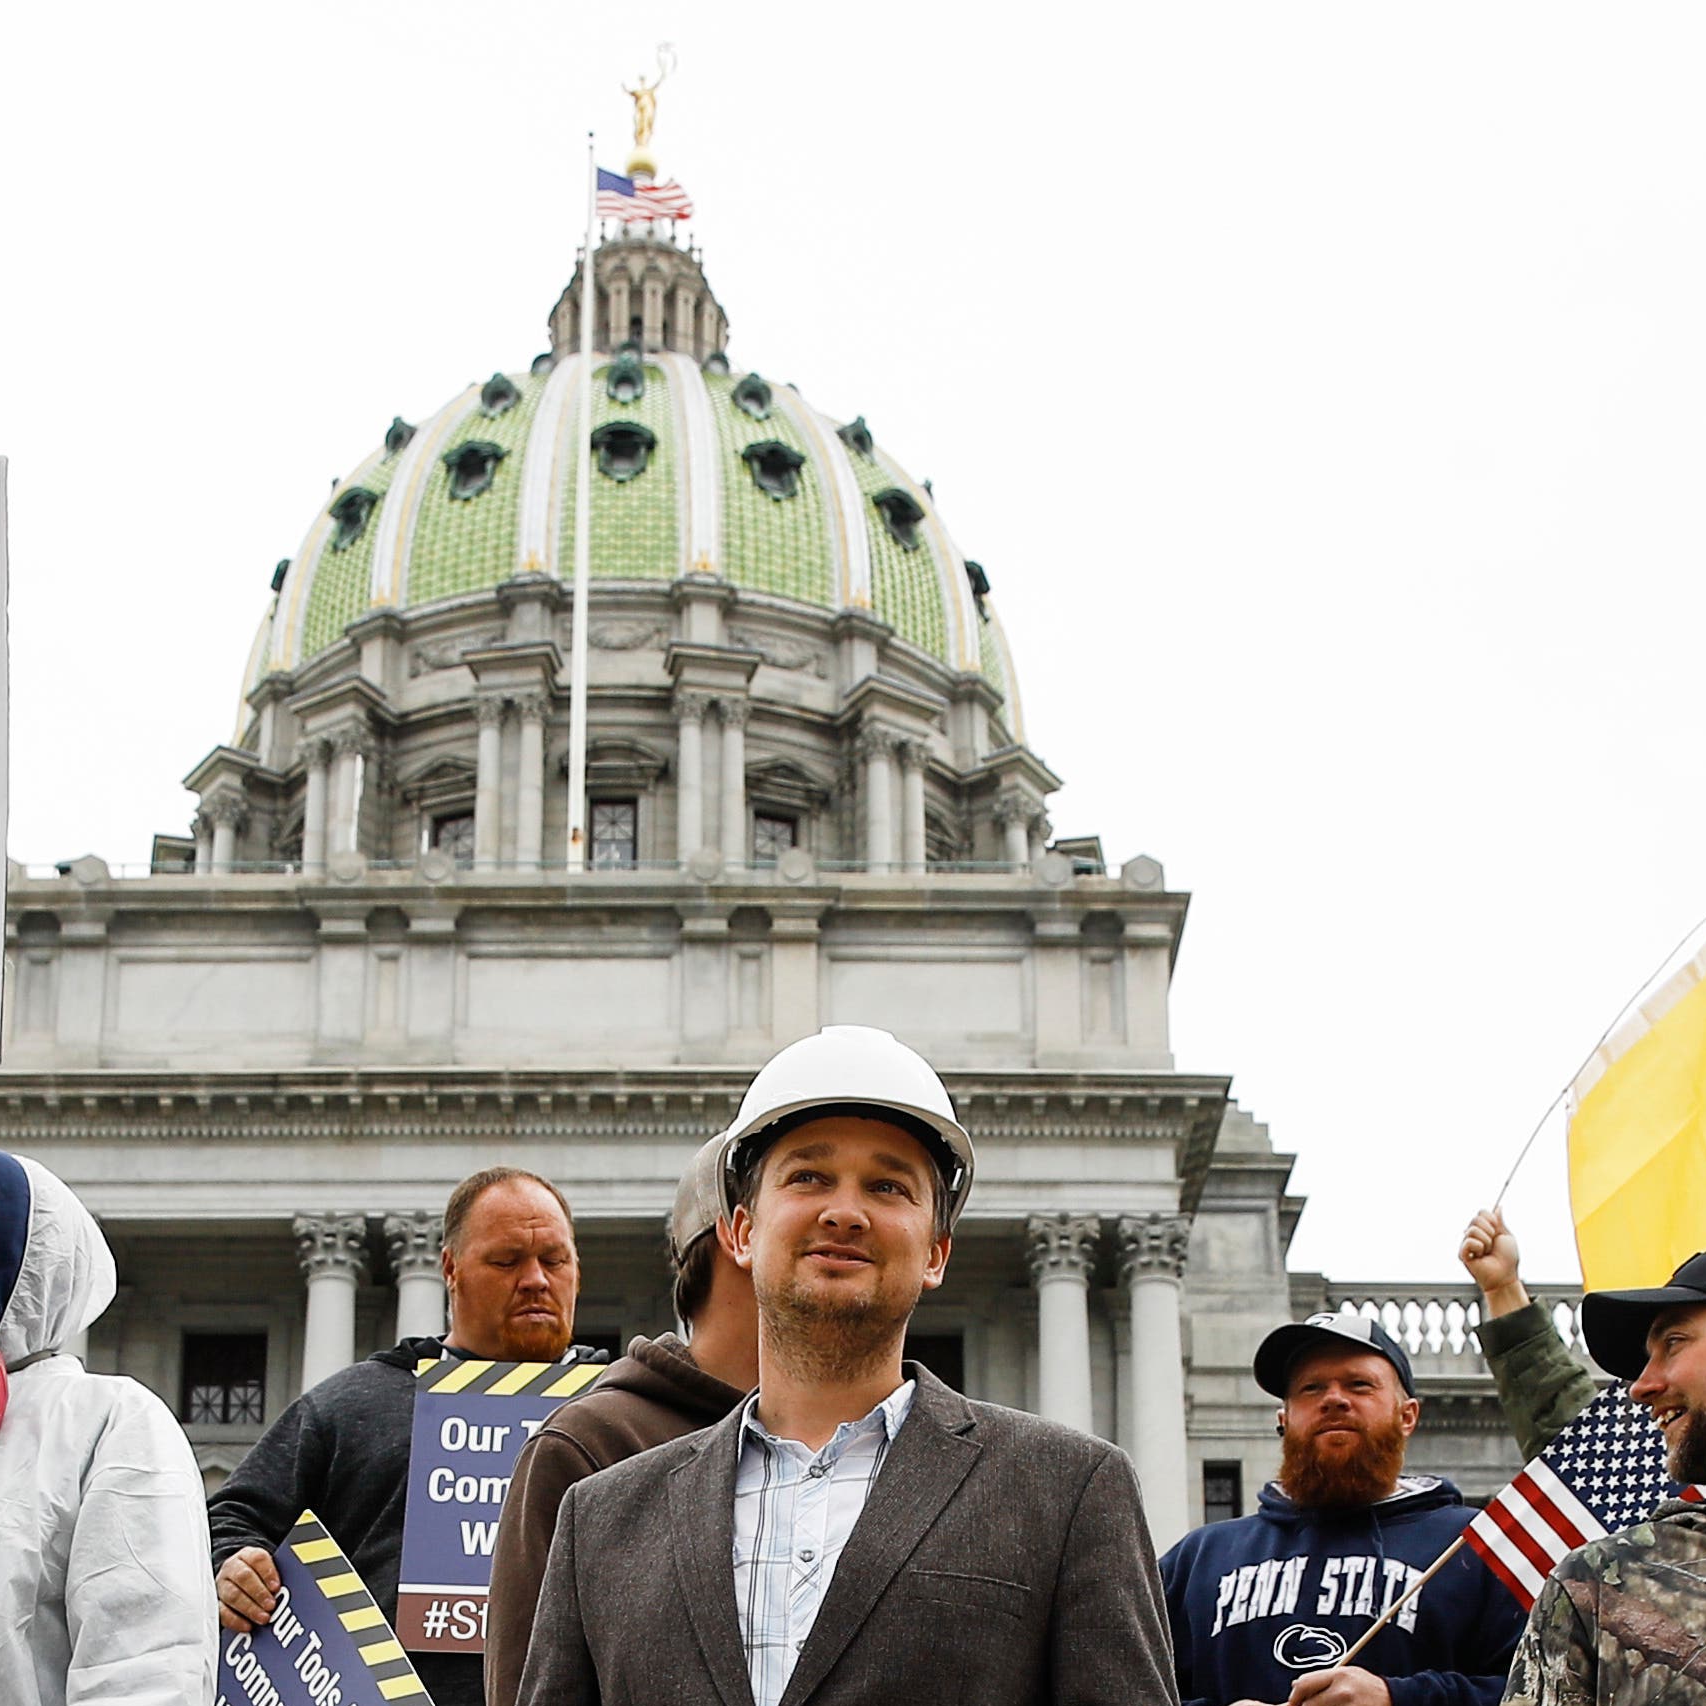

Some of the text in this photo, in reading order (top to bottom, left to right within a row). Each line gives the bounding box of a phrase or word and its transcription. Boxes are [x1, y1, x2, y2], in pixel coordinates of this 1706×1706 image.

[440, 1416, 511, 1452] Our
[269, 1586, 305, 1648] Our
[1210, 1555, 1426, 1638] PENN STATE
